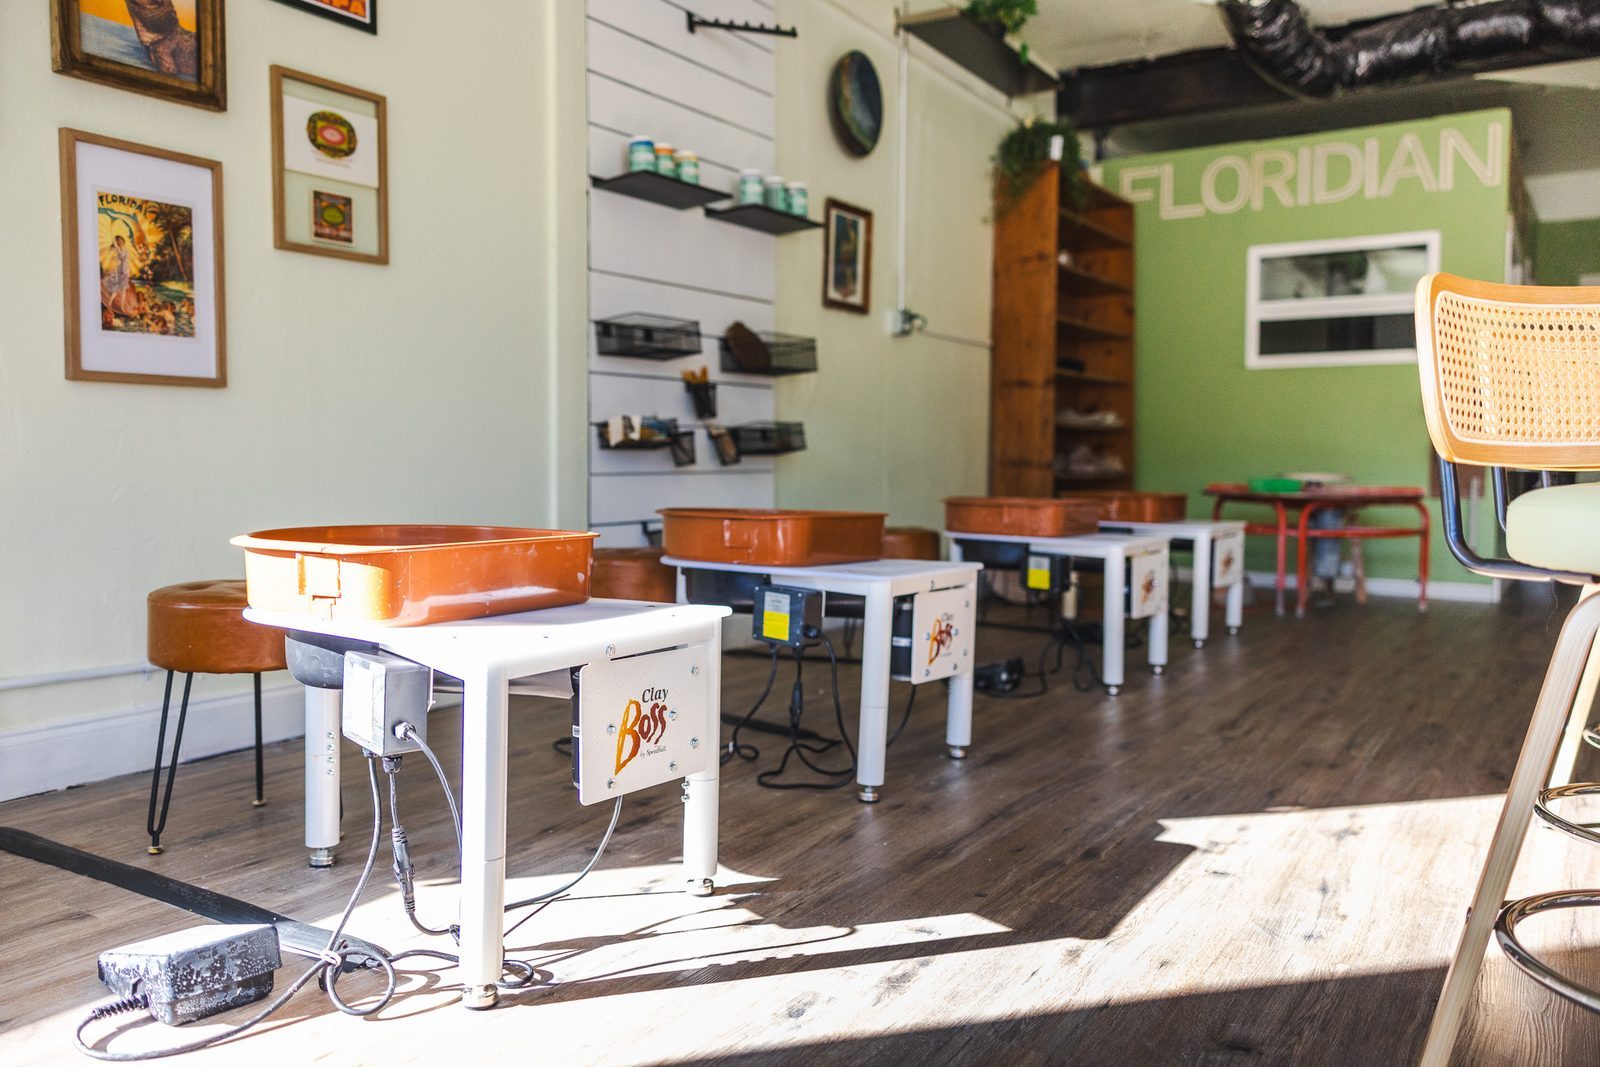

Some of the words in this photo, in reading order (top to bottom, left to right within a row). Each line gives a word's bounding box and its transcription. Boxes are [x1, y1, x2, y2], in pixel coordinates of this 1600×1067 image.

[1119, 121, 1502, 221] FLORIDIAN
[98, 194, 143, 213] FLORIDA
[642, 686, 669, 703] Clay
[614, 698, 668, 776] Boss
